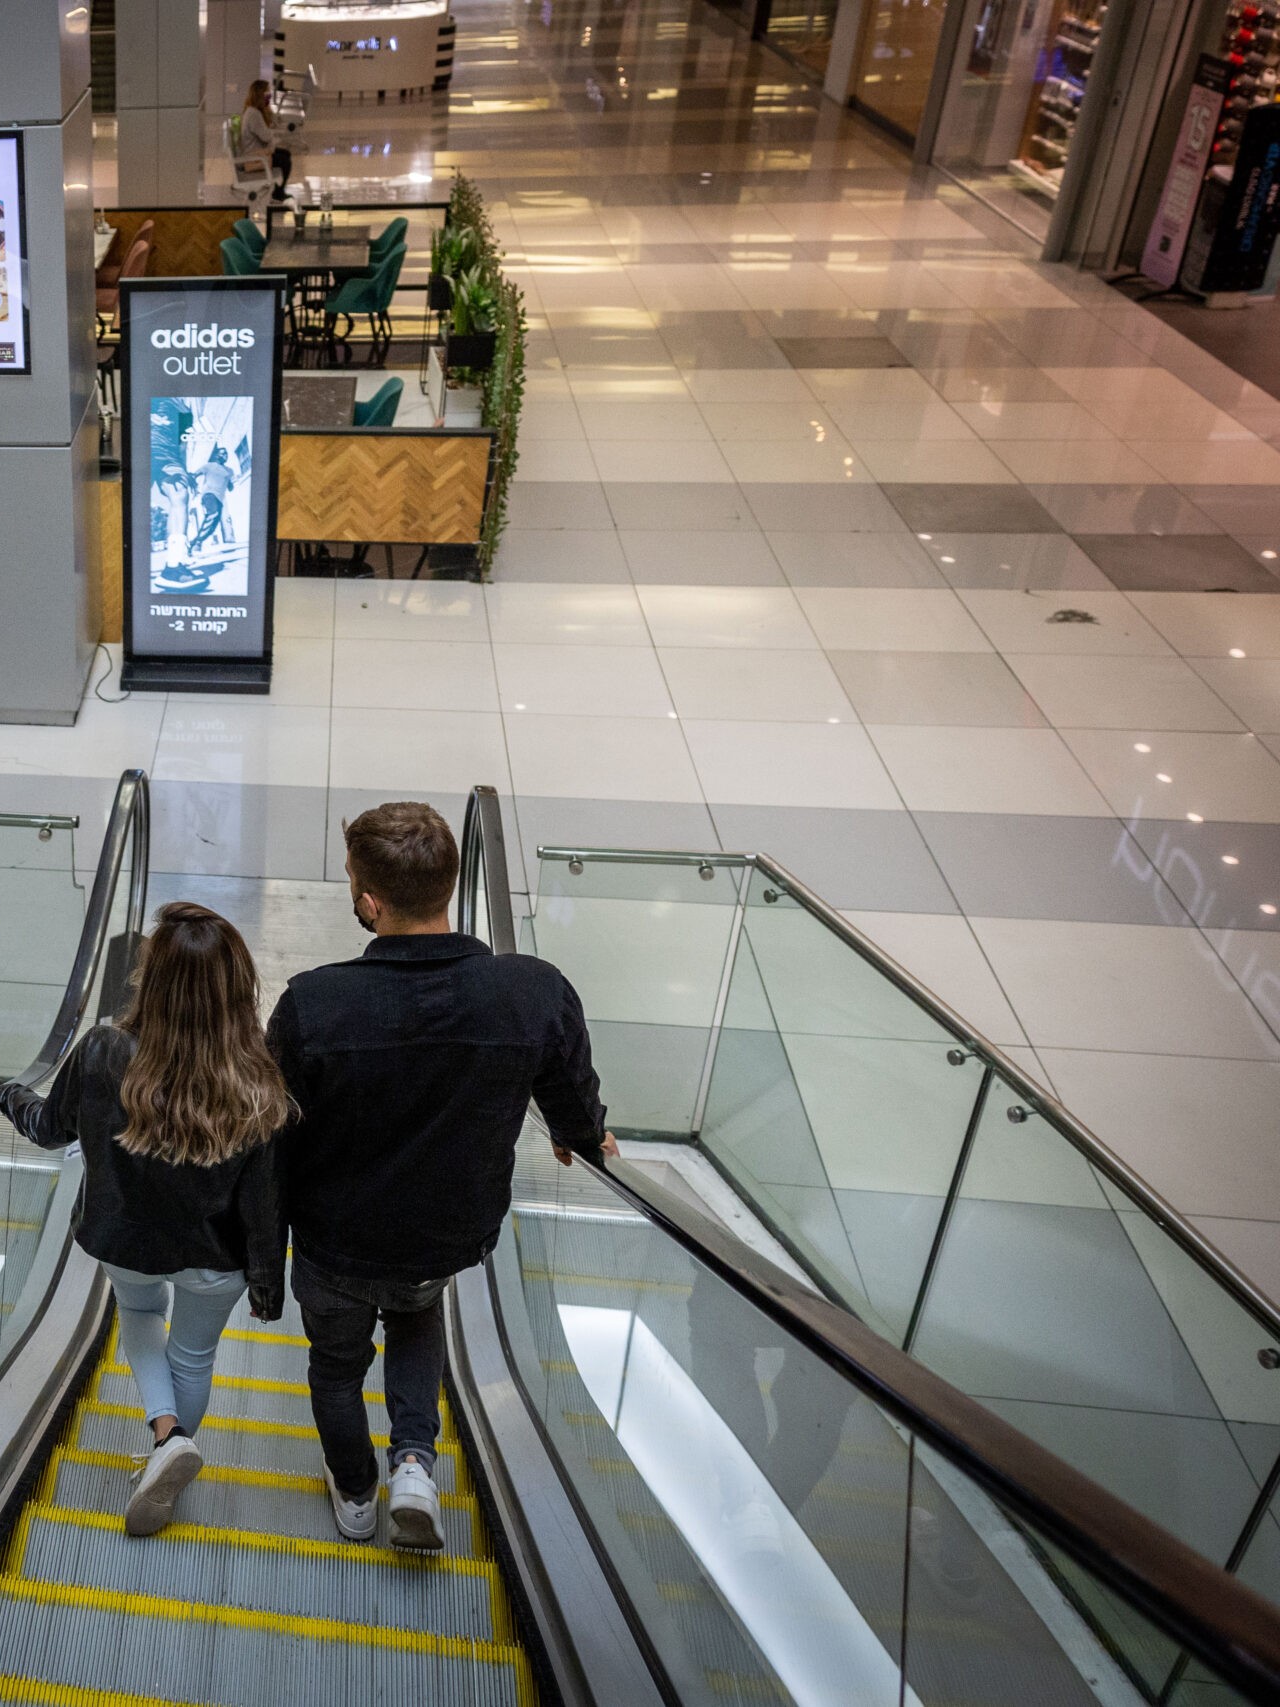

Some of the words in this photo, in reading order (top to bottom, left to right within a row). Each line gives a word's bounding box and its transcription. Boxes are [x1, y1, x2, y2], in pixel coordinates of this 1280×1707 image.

[151, 323, 255, 348] adidas
[163, 350, 242, 375] outlet
[149, 605, 202, 617] החדשה
[204, 606, 248, 618] החנות
[191, 620, 228, 635] קומה
